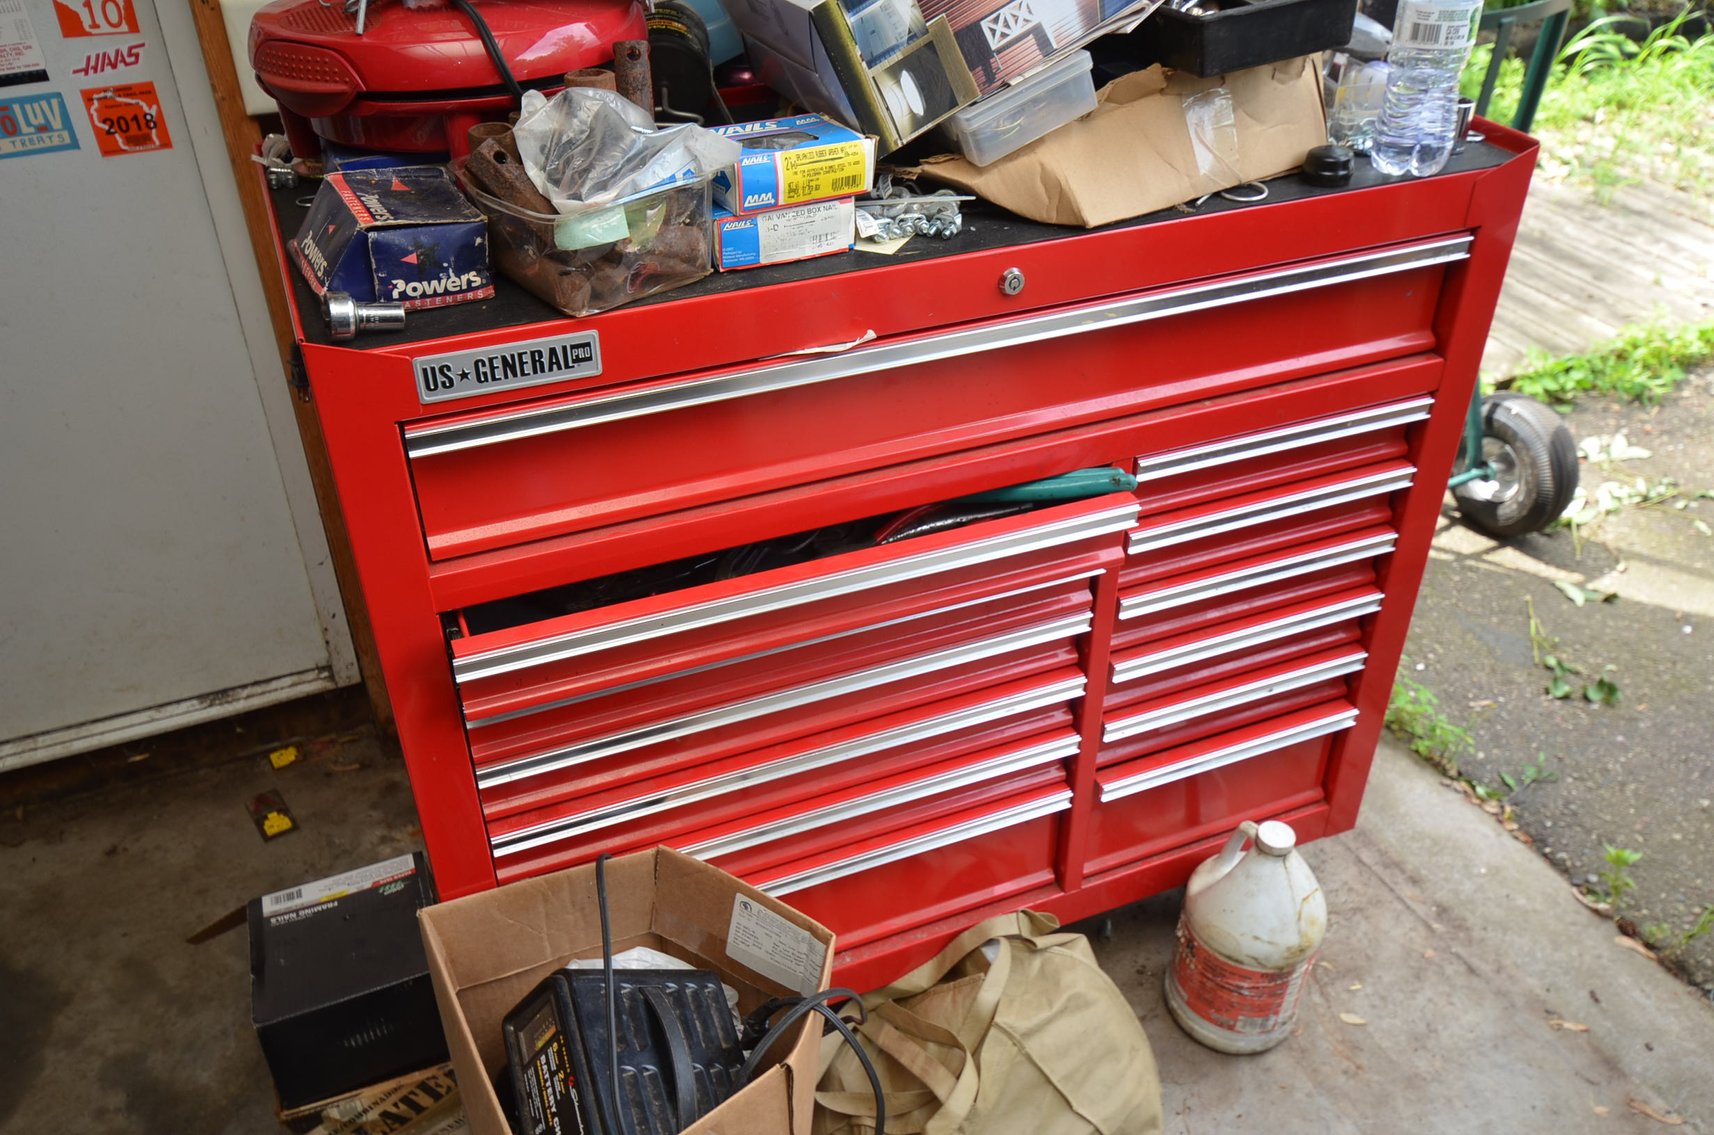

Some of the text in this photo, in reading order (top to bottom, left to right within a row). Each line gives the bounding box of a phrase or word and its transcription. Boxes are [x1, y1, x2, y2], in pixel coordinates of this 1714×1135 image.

[72, 43, 146, 76] HAAS
[101, 114, 158, 136] 2018
[9, 133, 66, 149] TREATS
[742, 155, 770, 166] NAILS
[723, 219, 754, 231] NAILS
[391, 270, 482, 300] Powers
[403, 290, 484, 309] ASTENERS
[422, 344, 592, 392] US GENERAL PRO
[270, 912, 298, 924] NAILS
[299, 901, 339, 917] FRAMING
[540, 1054, 557, 1113] BATTERY
